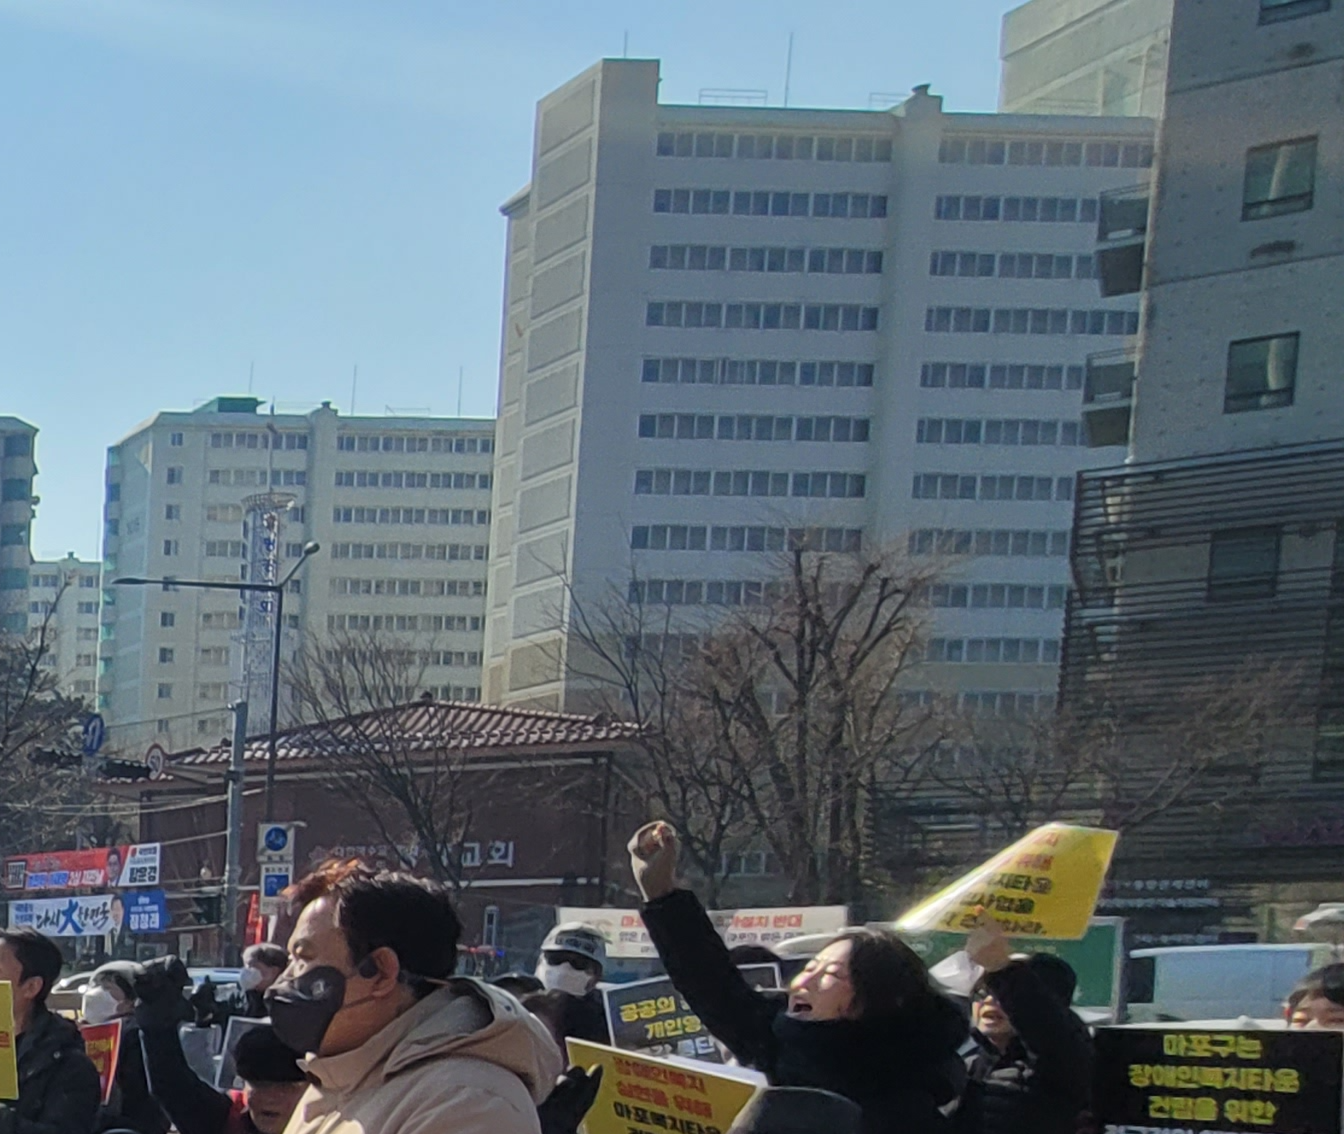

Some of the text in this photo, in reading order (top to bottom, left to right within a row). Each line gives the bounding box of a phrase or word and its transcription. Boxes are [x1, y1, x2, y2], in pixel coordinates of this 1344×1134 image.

[619, 995, 676, 1022] 공공의
[1163, 1034, 1262, 1060] 마포구는
[1128, 1063, 1300, 1094] 장애인복지타운
[1148, 1095, 1278, 1125] 건립을 위한
